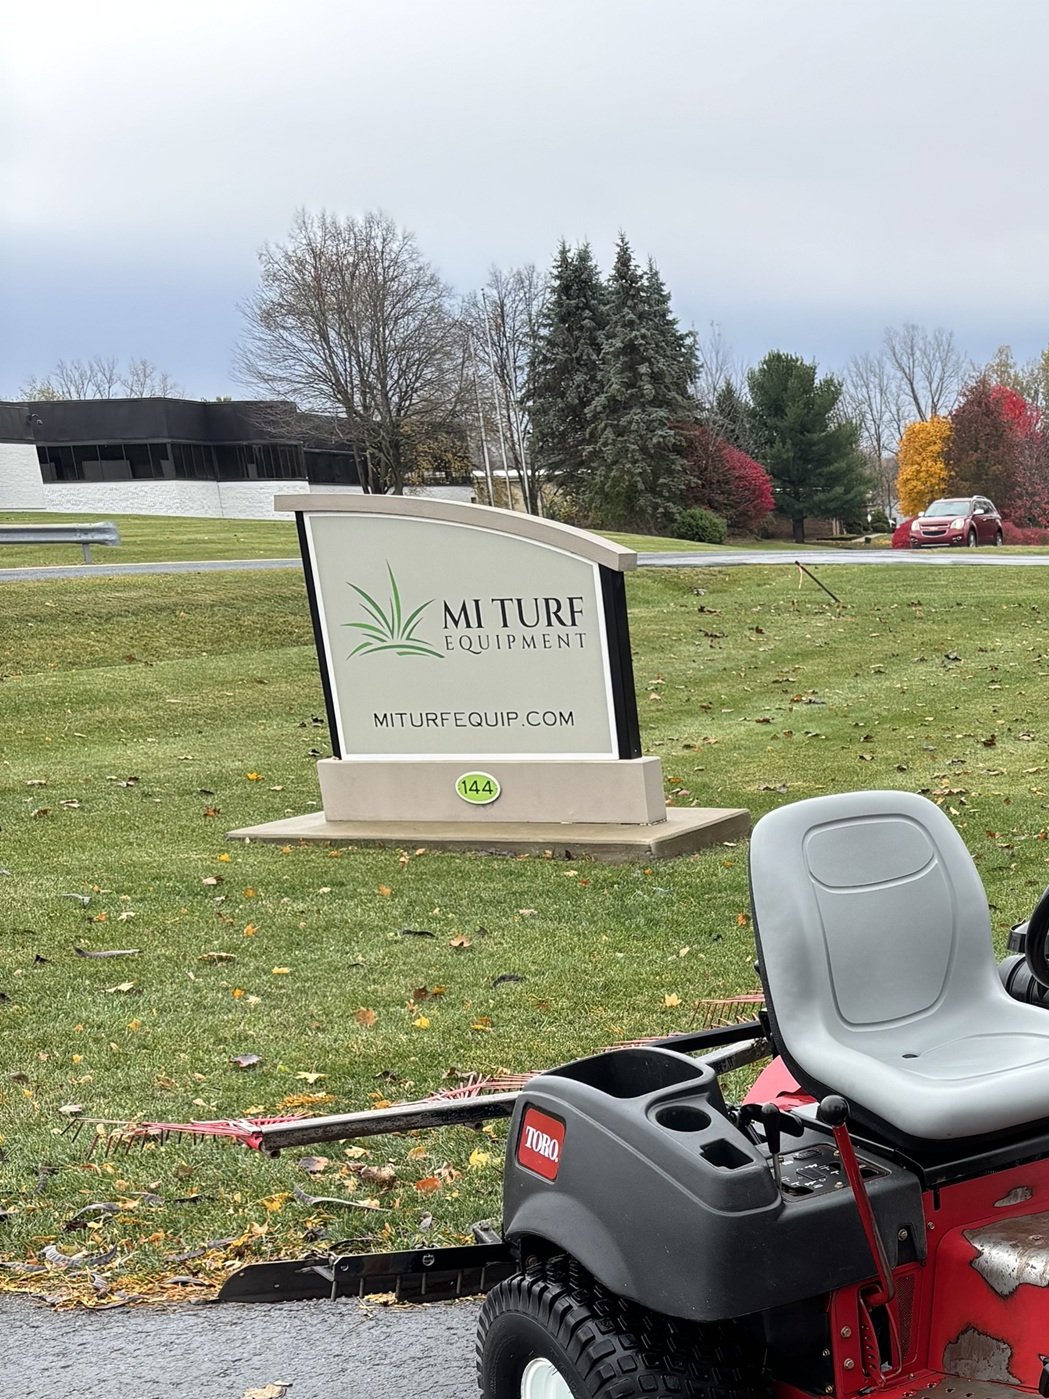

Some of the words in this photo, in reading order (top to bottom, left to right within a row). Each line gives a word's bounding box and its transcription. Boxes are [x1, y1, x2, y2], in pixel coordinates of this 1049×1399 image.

[442, 598, 485, 630] MI
[491, 596, 584, 629] TURF
[444, 632, 587, 655] EQUIPMENT
[373, 710, 575, 728] MITURFEQUIP.COM
[461, 779, 494, 795] 144
